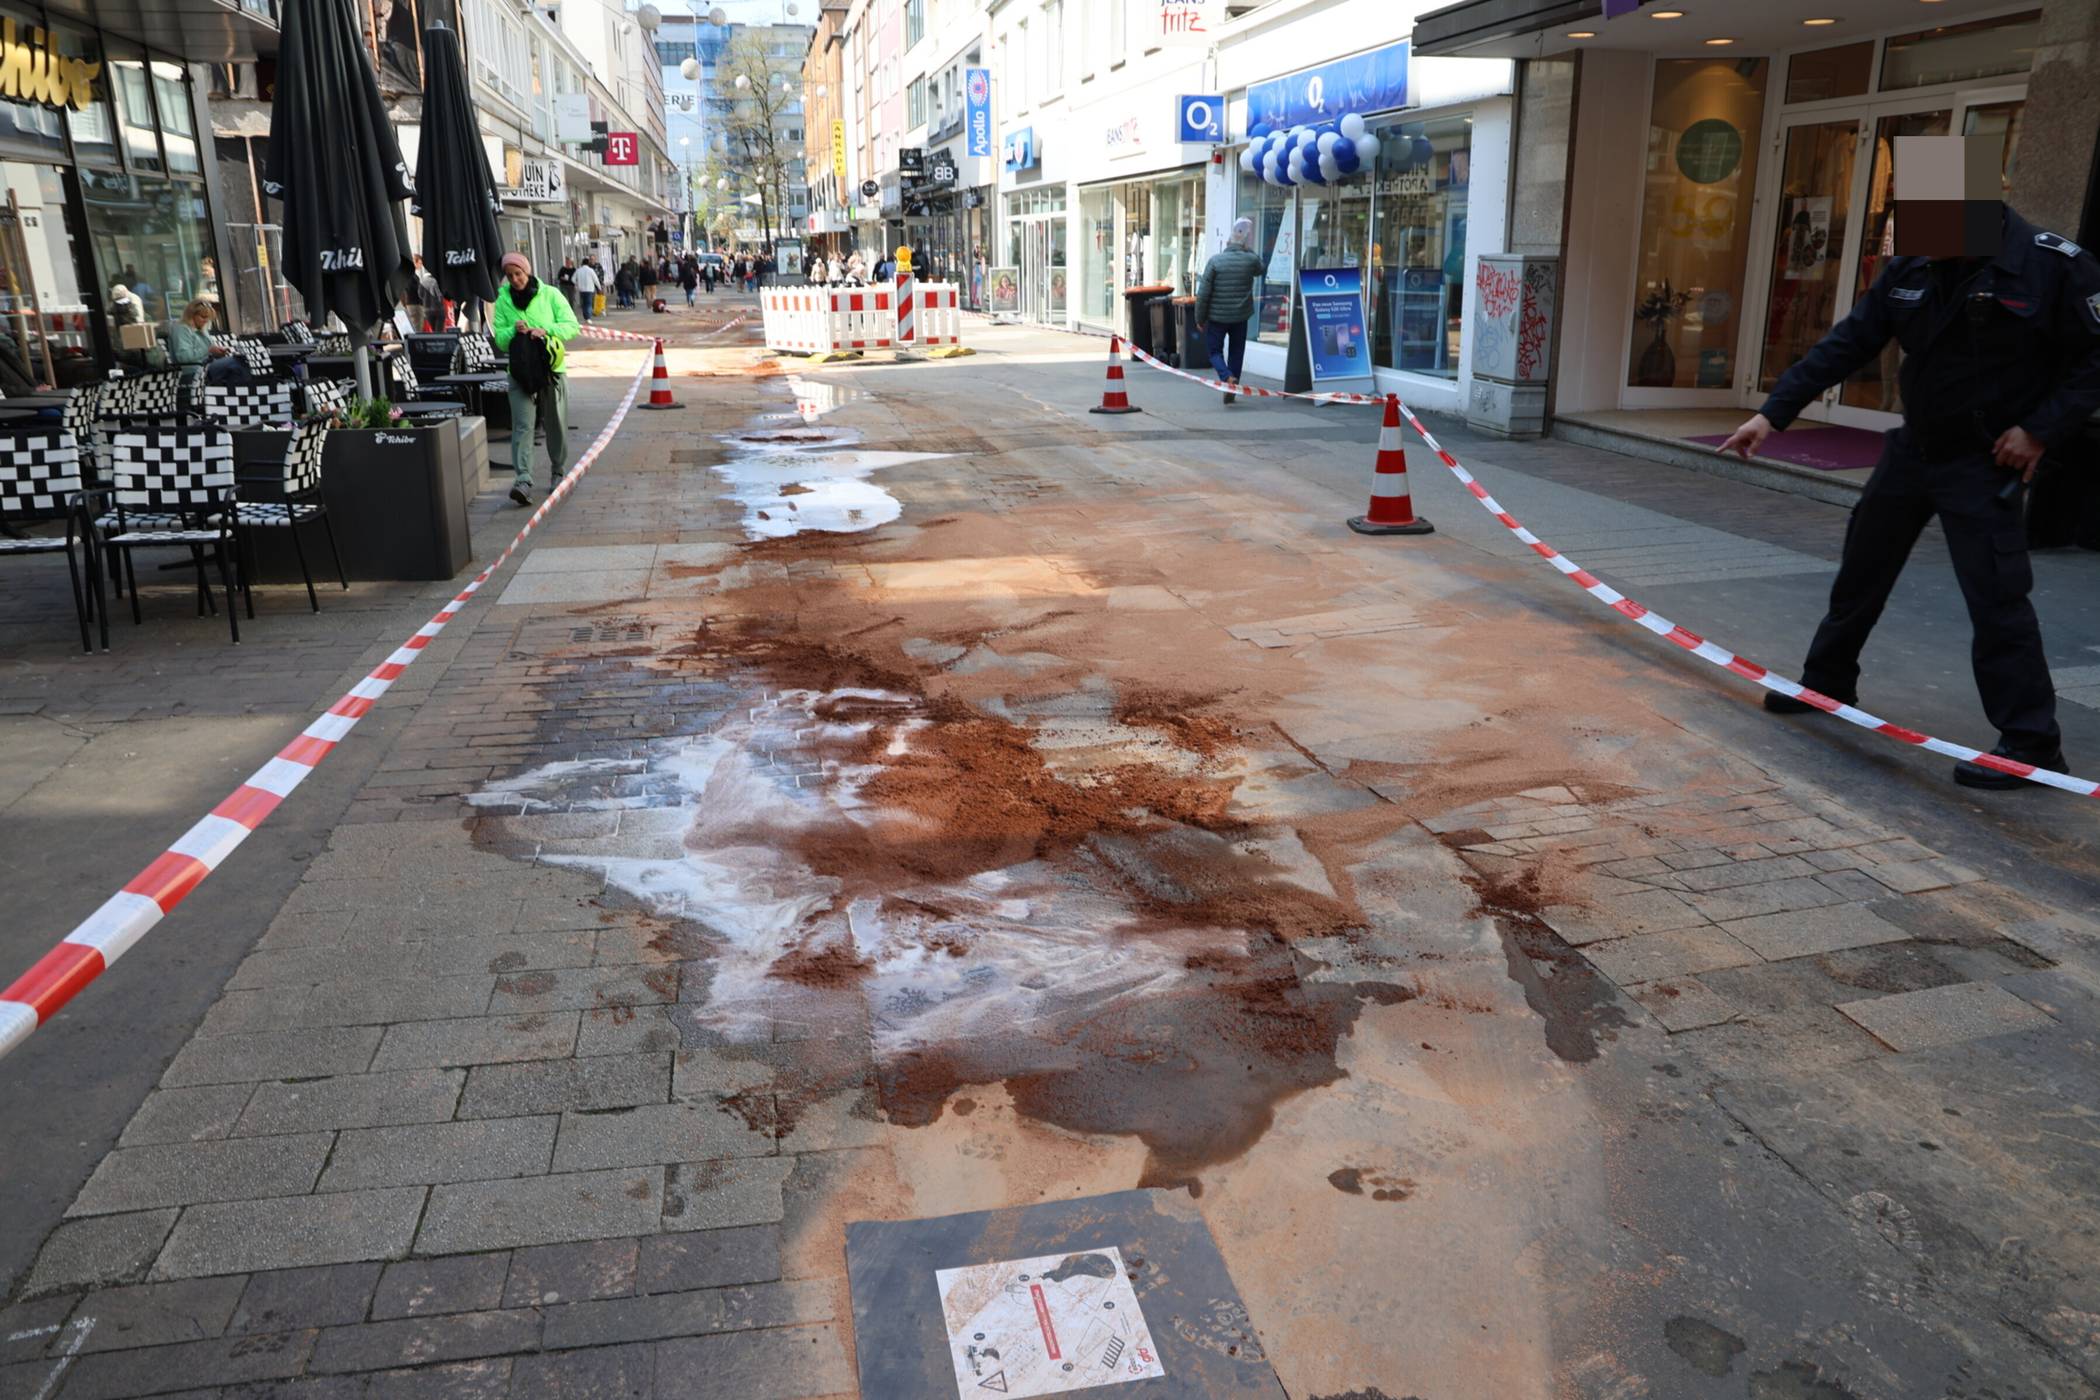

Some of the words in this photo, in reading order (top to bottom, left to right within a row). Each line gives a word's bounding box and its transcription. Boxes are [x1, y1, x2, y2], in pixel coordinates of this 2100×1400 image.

[1160, 6, 1207, 35] fritz
[0, 16, 100, 112] hibo
[973, 110, 988, 155] Apollo
[611, 137, 631, 160] T
[385, 434, 416, 444] Tchibo
